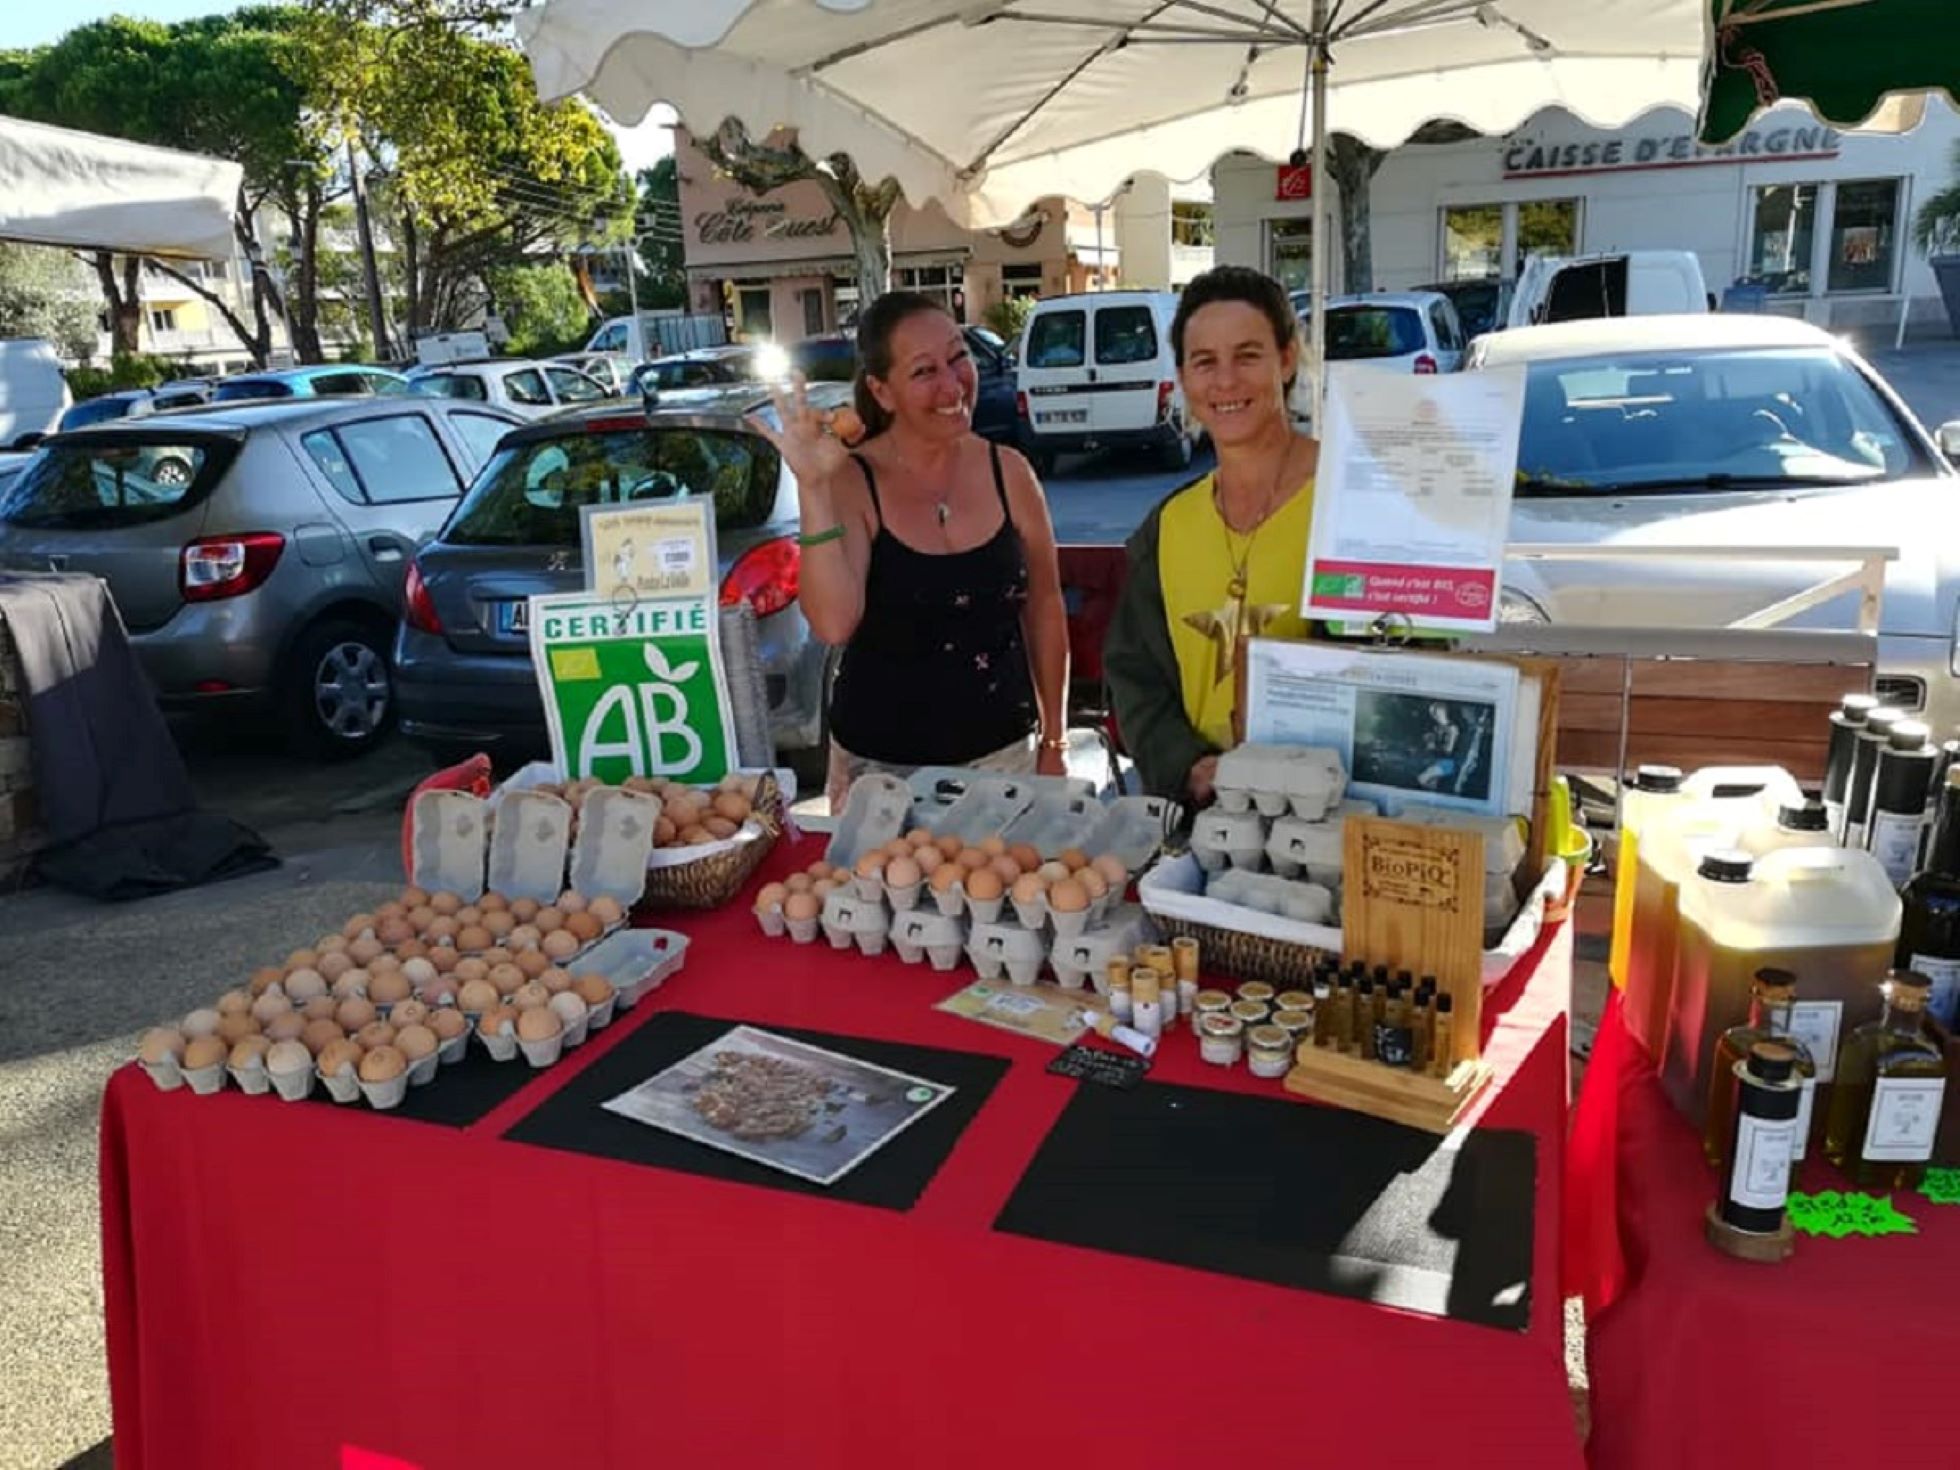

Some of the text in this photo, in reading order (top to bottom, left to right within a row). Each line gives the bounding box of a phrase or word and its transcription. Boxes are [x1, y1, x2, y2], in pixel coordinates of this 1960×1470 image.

[1505, 126, 1840, 171] CAISSE D'EARGNE
[579, 683, 702, 781] AB
